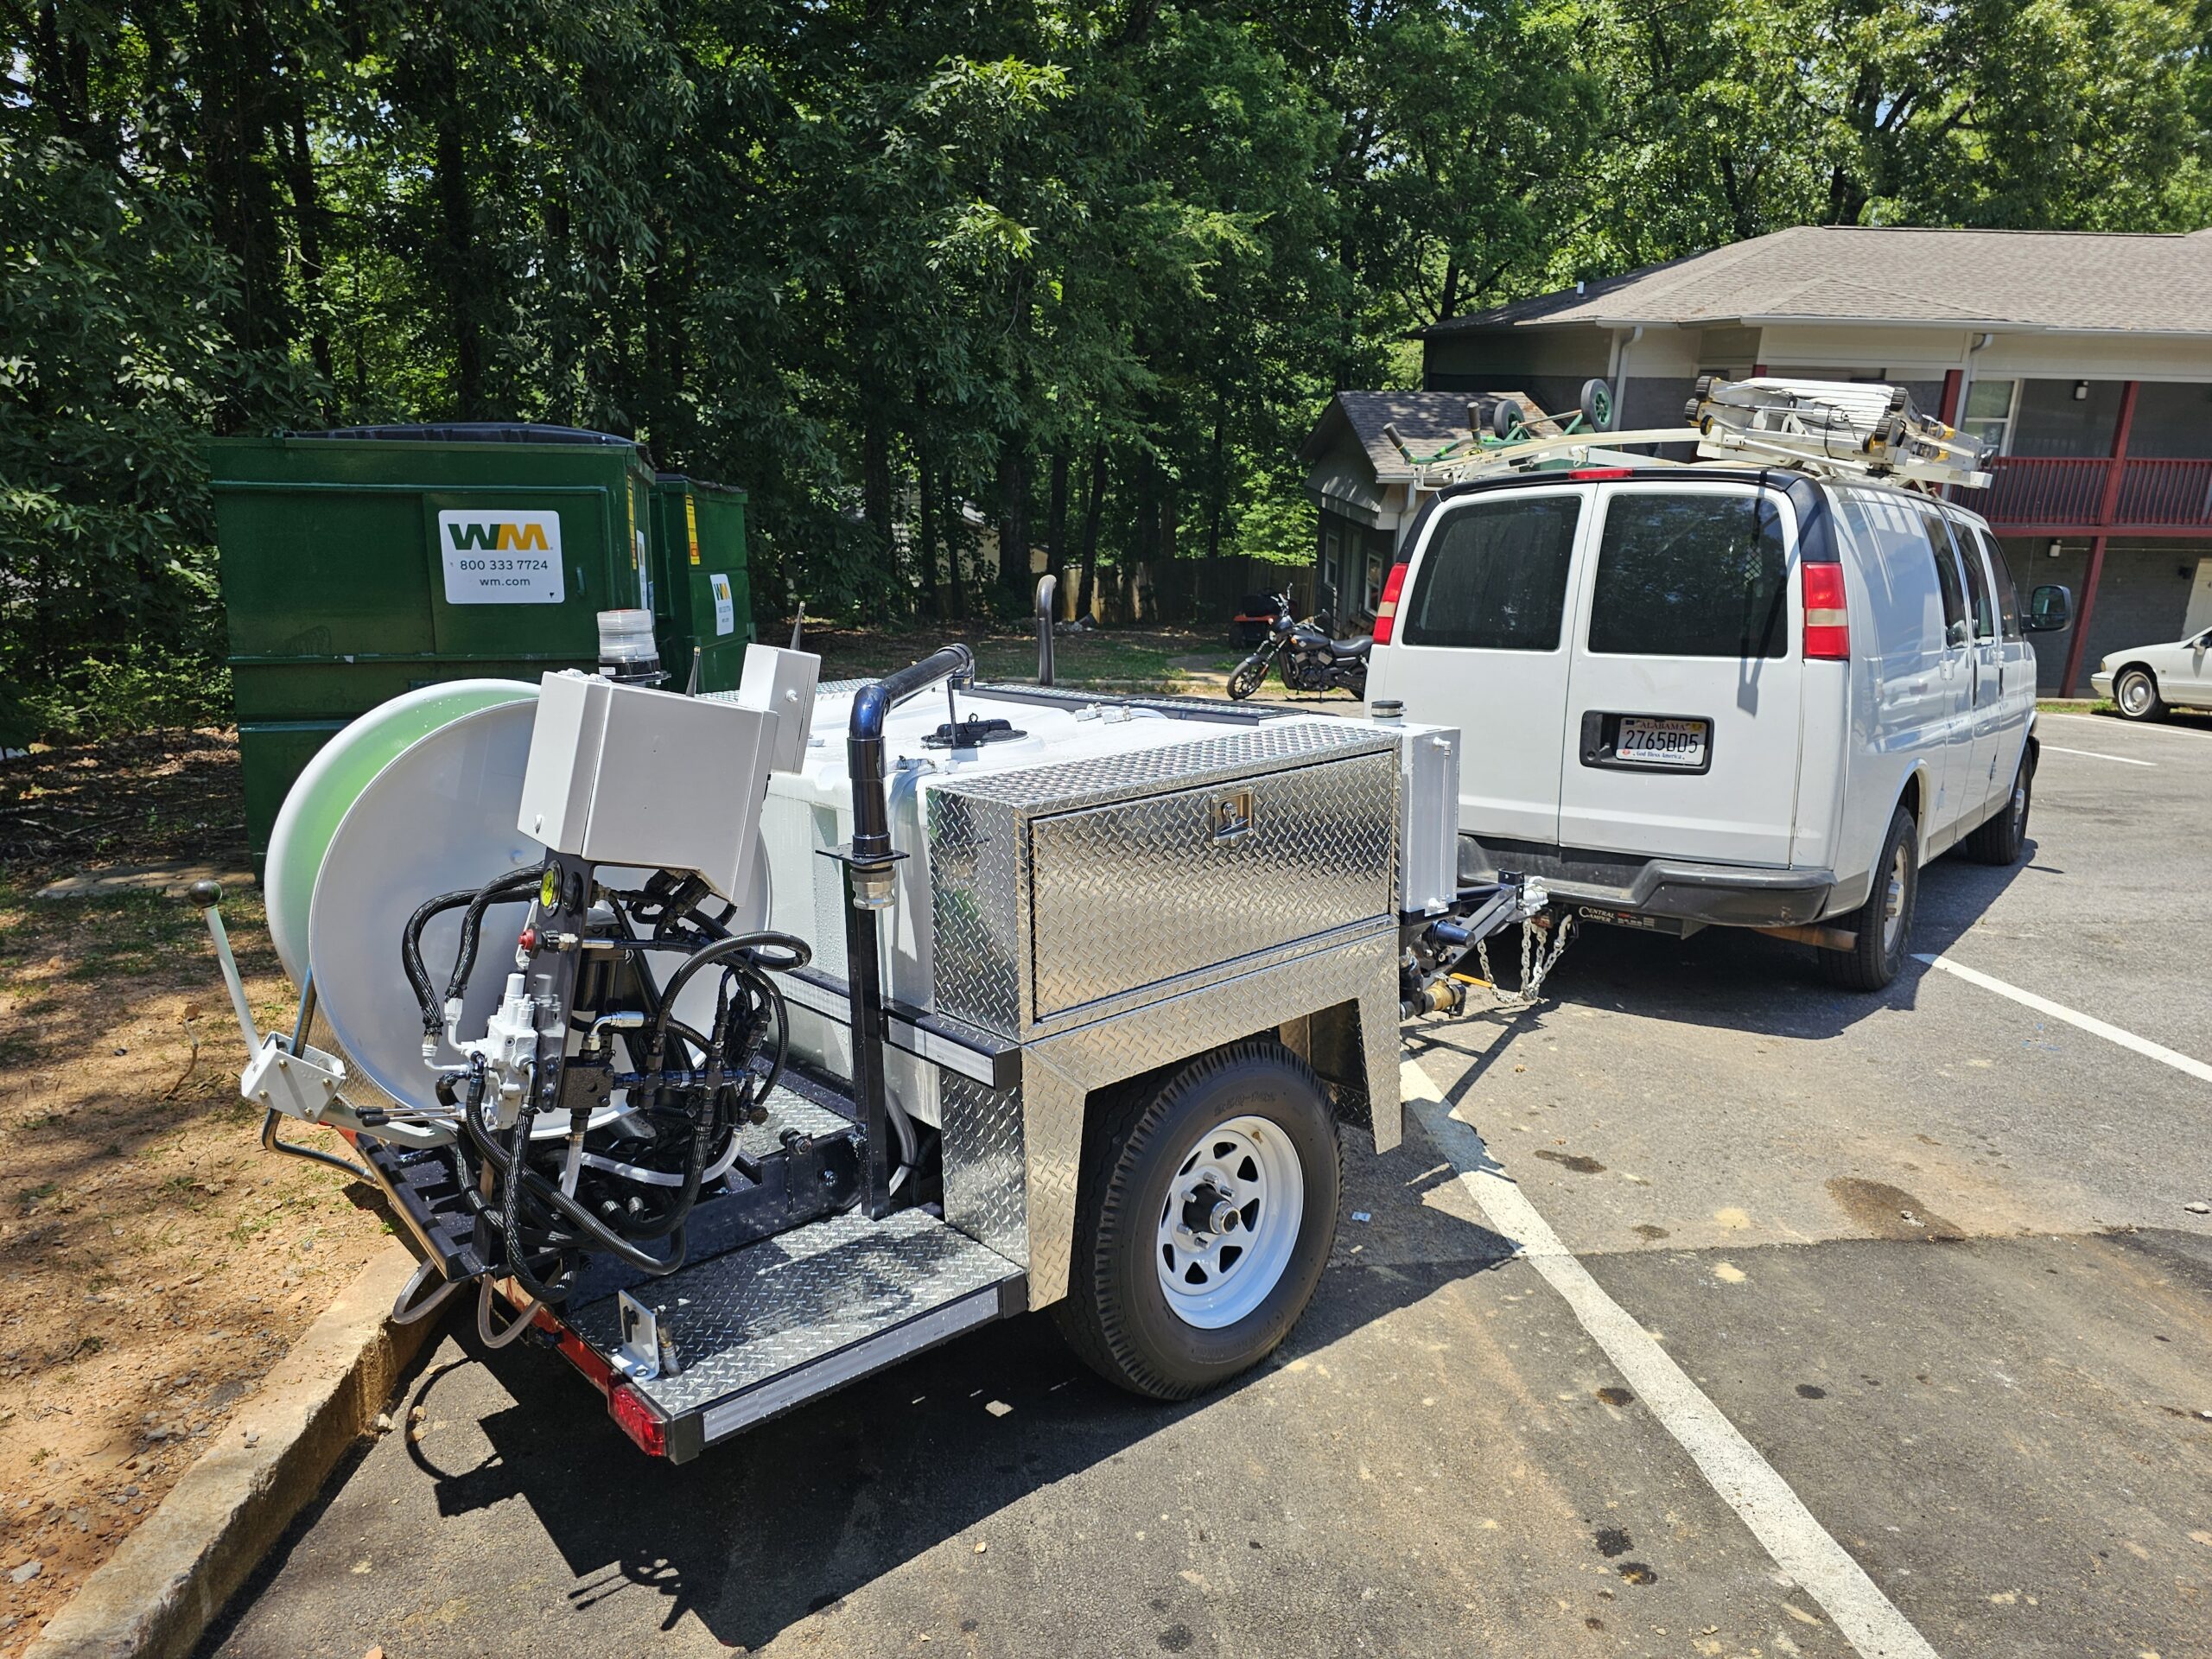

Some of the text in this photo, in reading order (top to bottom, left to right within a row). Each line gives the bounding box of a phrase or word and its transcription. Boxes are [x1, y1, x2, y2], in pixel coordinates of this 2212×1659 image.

[448, 524, 549, 550] WM
[460, 560, 548, 570] 800 333 7724
[1641, 721, 1686, 730] ALABAMA
[1624, 729, 1699, 753] 2765BD5
